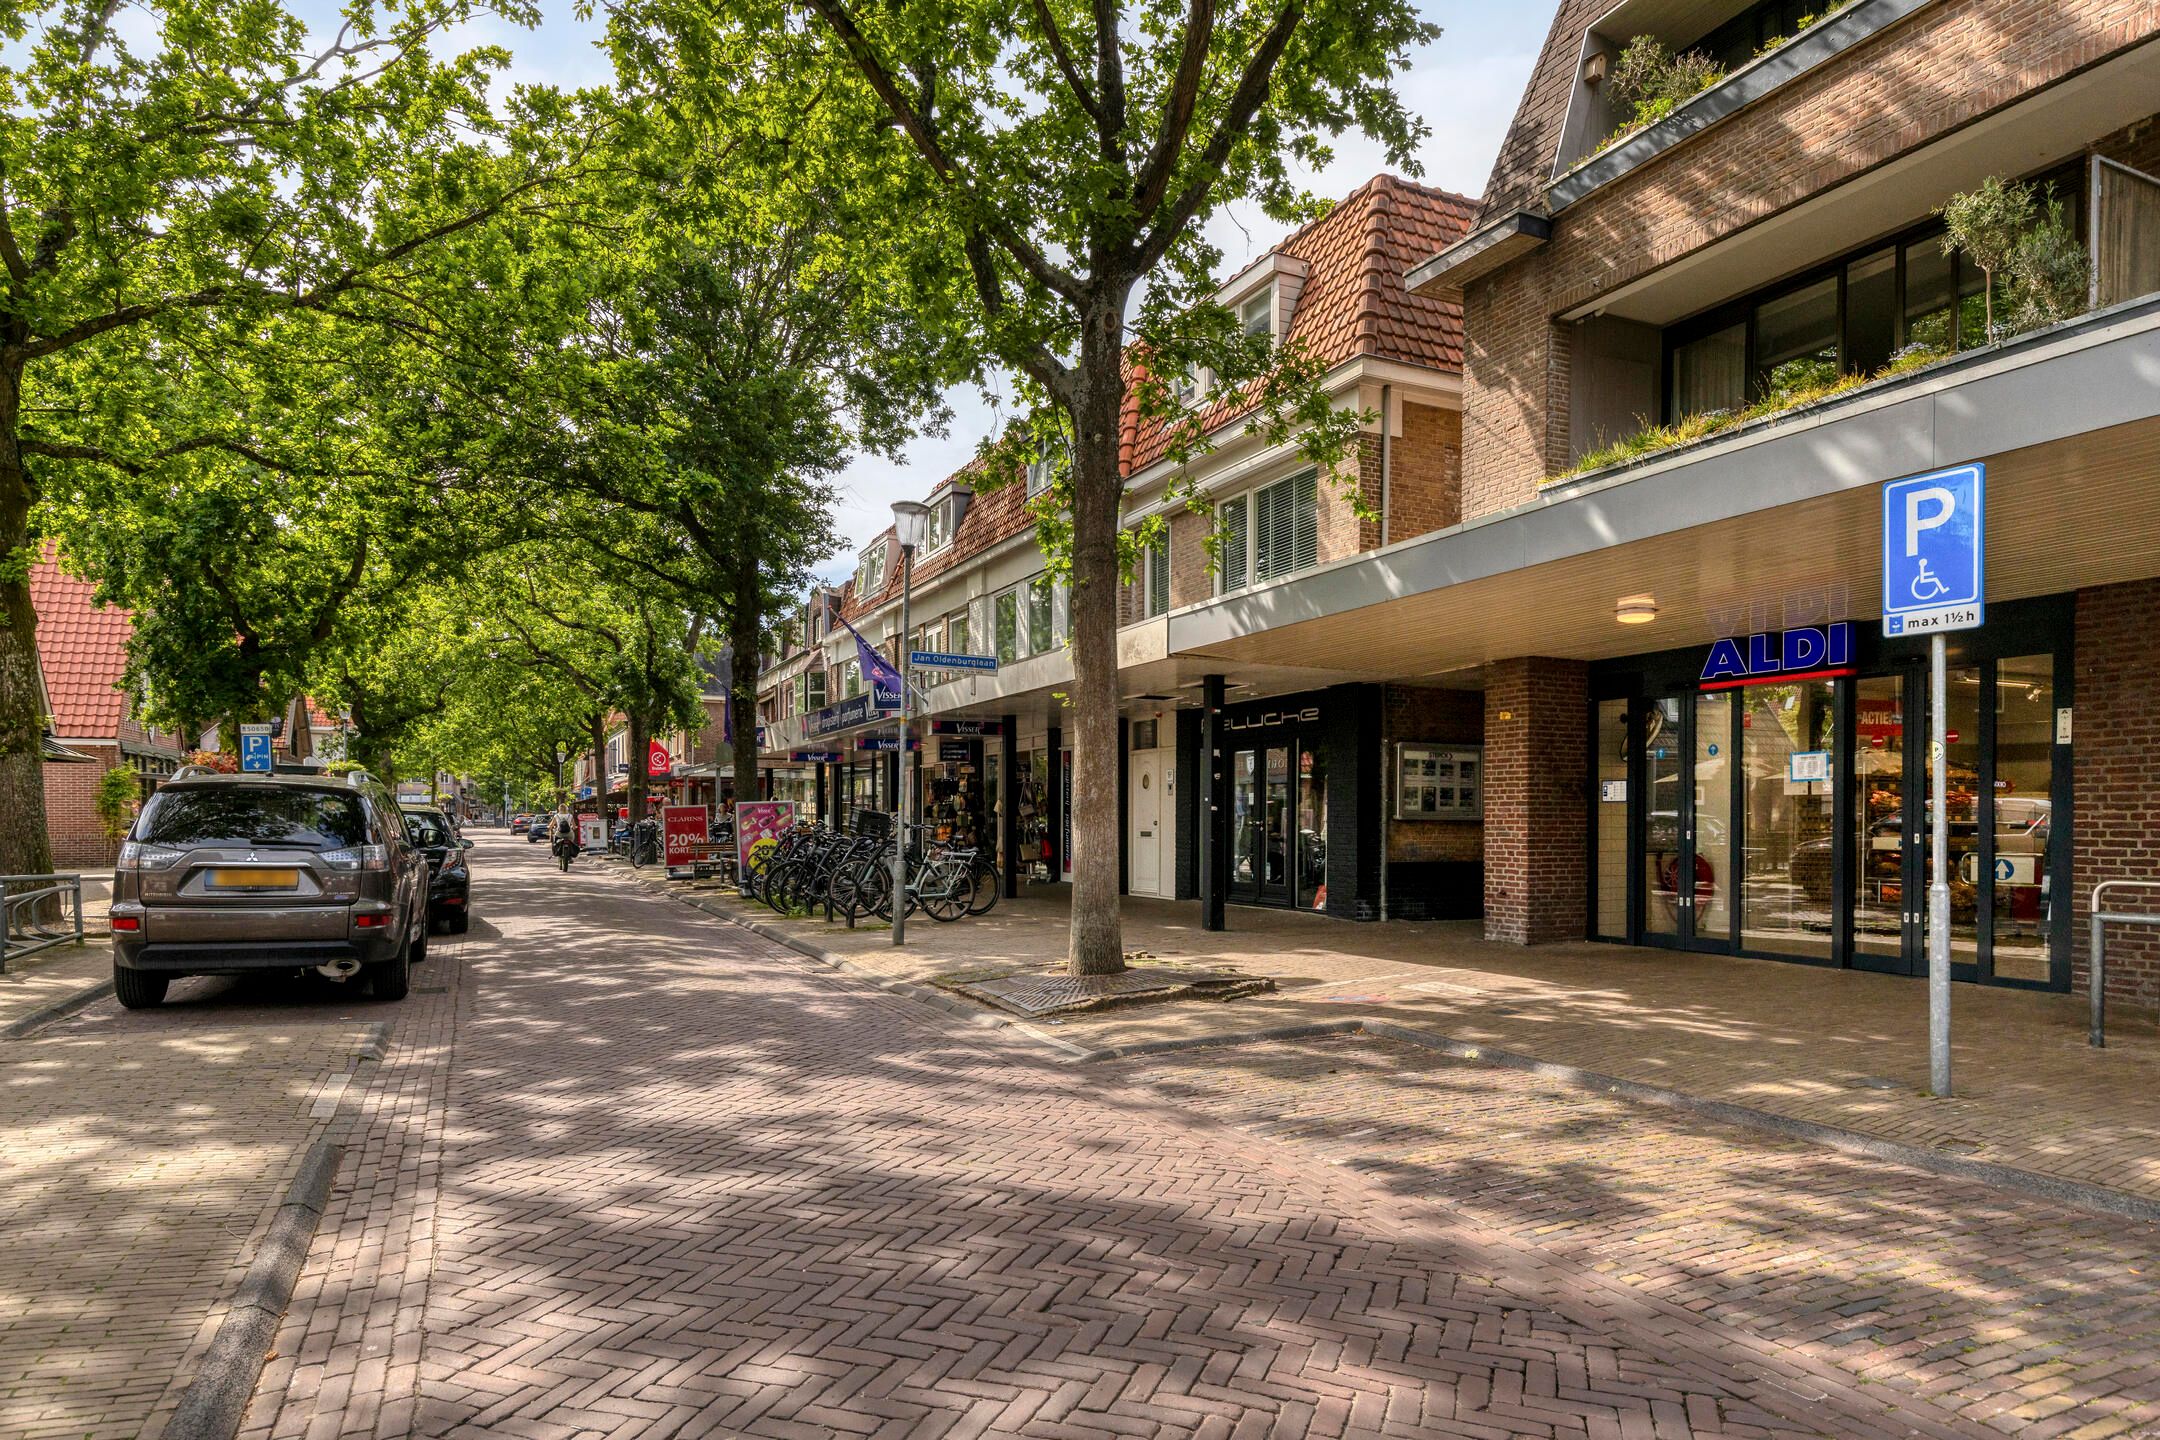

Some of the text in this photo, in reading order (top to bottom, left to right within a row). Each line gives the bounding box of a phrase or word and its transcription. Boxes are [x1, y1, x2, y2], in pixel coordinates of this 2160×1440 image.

[1906, 487, 1955, 557] P
[1908, 617, 1938, 628] max
[1700, 622, 1848, 680] ALDI
[914, 654, 994, 668] Jan Oldenburglaan
[250, 737, 263, 752] P
[667, 815, 703, 823] CLARINS
[669, 832, 704, 847] 20%
